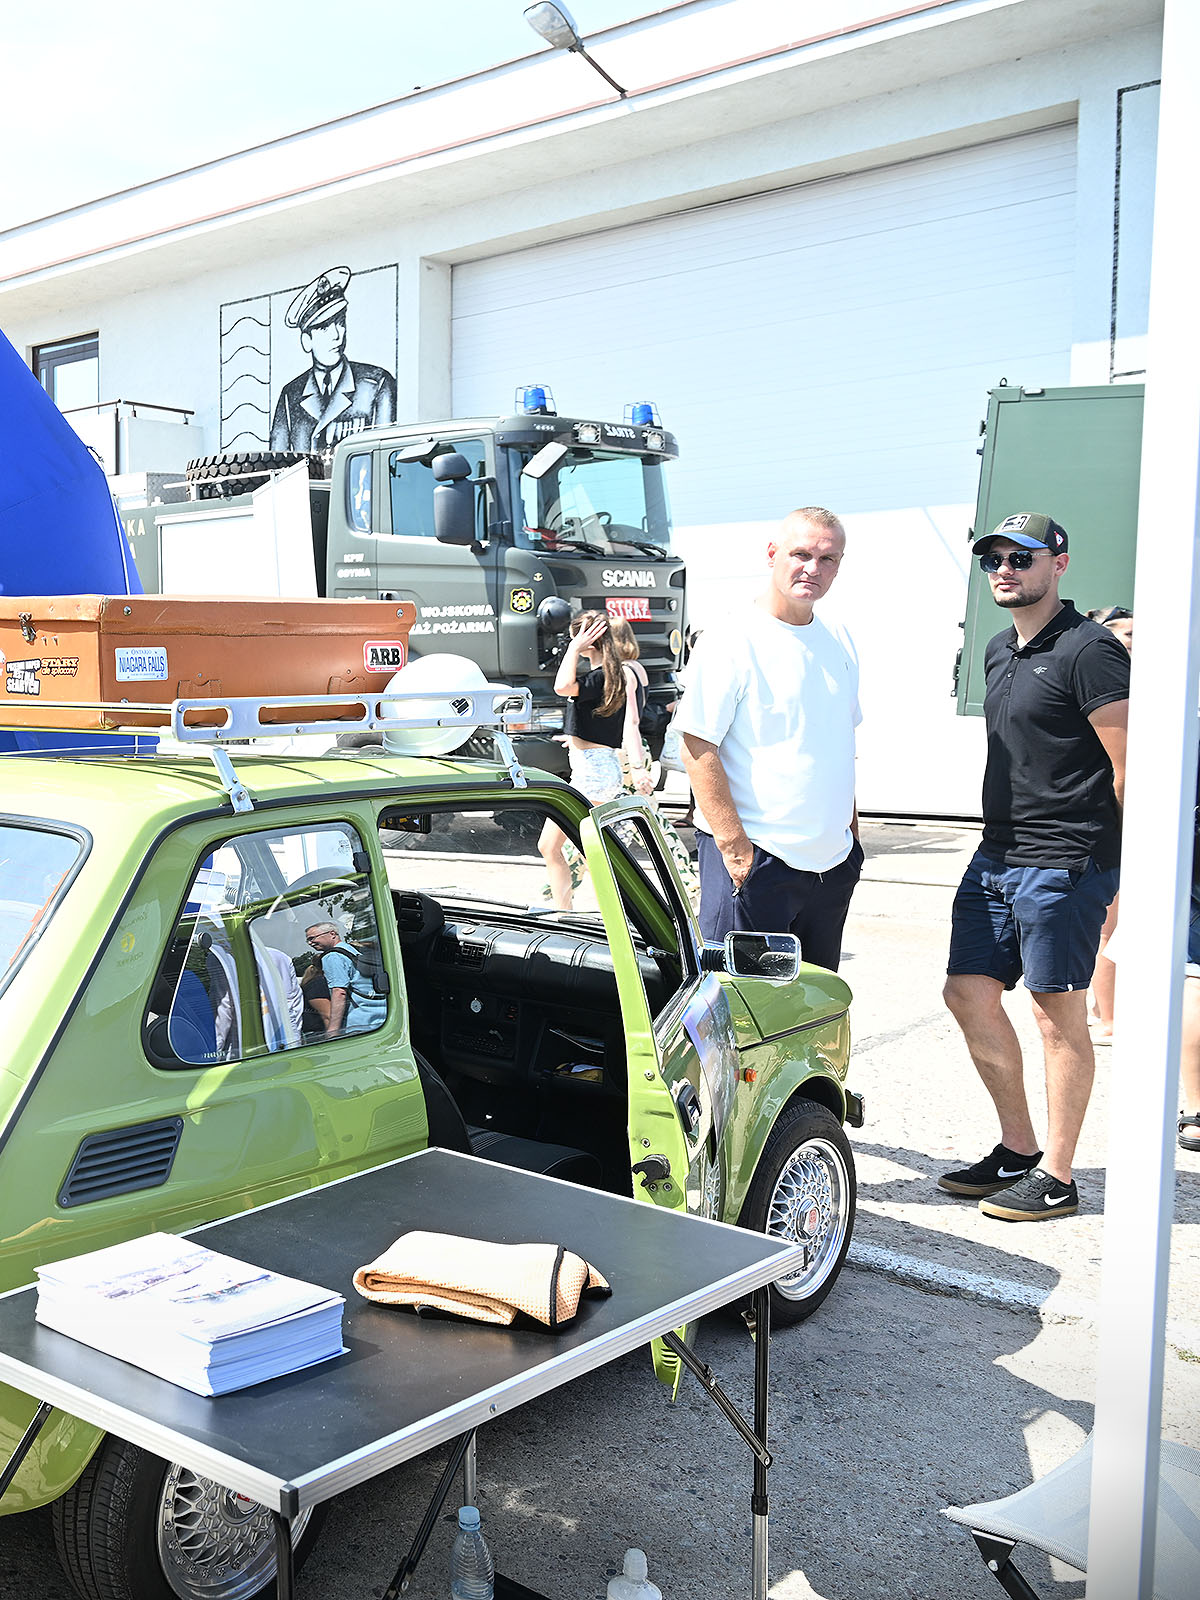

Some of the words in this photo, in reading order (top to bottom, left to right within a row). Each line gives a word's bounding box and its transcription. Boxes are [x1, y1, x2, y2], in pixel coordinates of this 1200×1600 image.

[337, 568, 371, 578] GDYNIA
[602, 569, 657, 588] SCANIA
[420, 604, 494, 618] WOJSKOWA
[432, 620, 496, 634] POŻARNA
[41, 658, 79, 667] STARY
[119, 656, 147, 672] NIAGARA
[148, 656, 165, 672] FALLS
[370, 648, 400, 666] ARB
